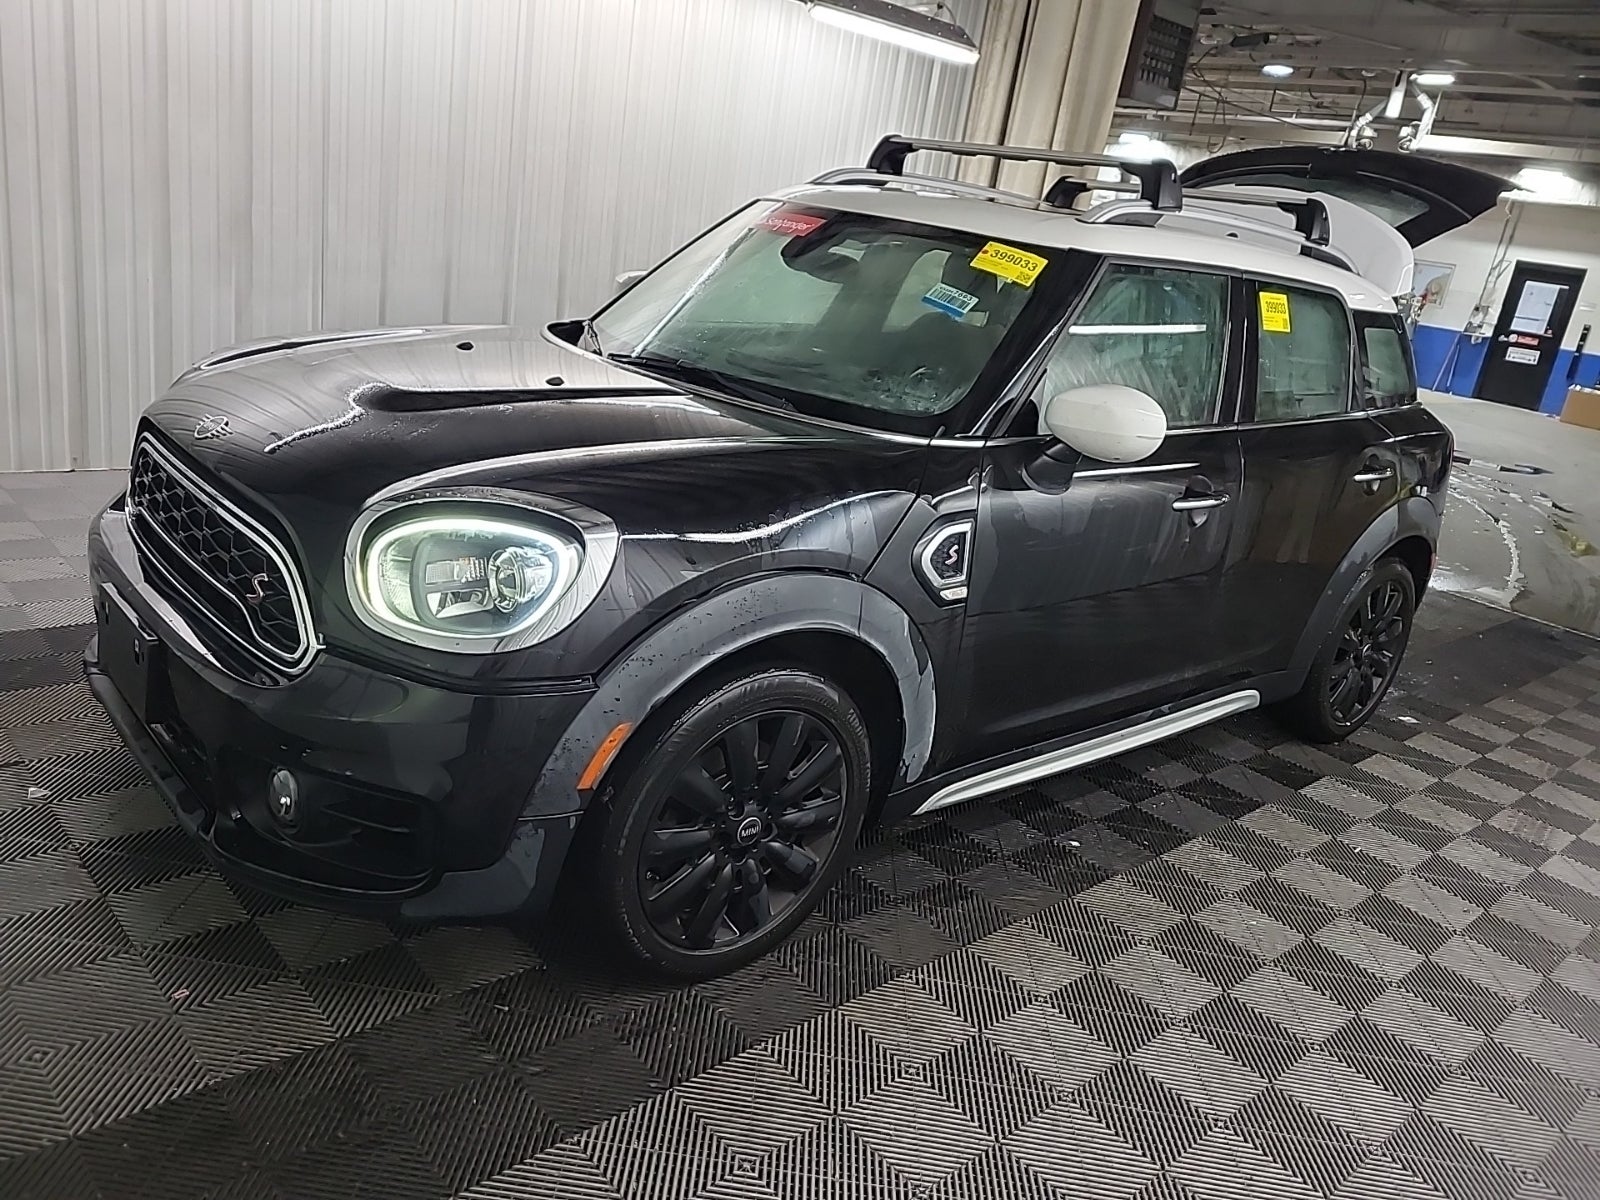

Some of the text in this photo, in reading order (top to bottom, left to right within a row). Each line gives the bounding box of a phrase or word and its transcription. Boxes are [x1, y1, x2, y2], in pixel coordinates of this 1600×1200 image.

[989, 249, 1038, 272] 399033
[245, 572, 269, 604] S
[741, 825, 759, 838] MINI
